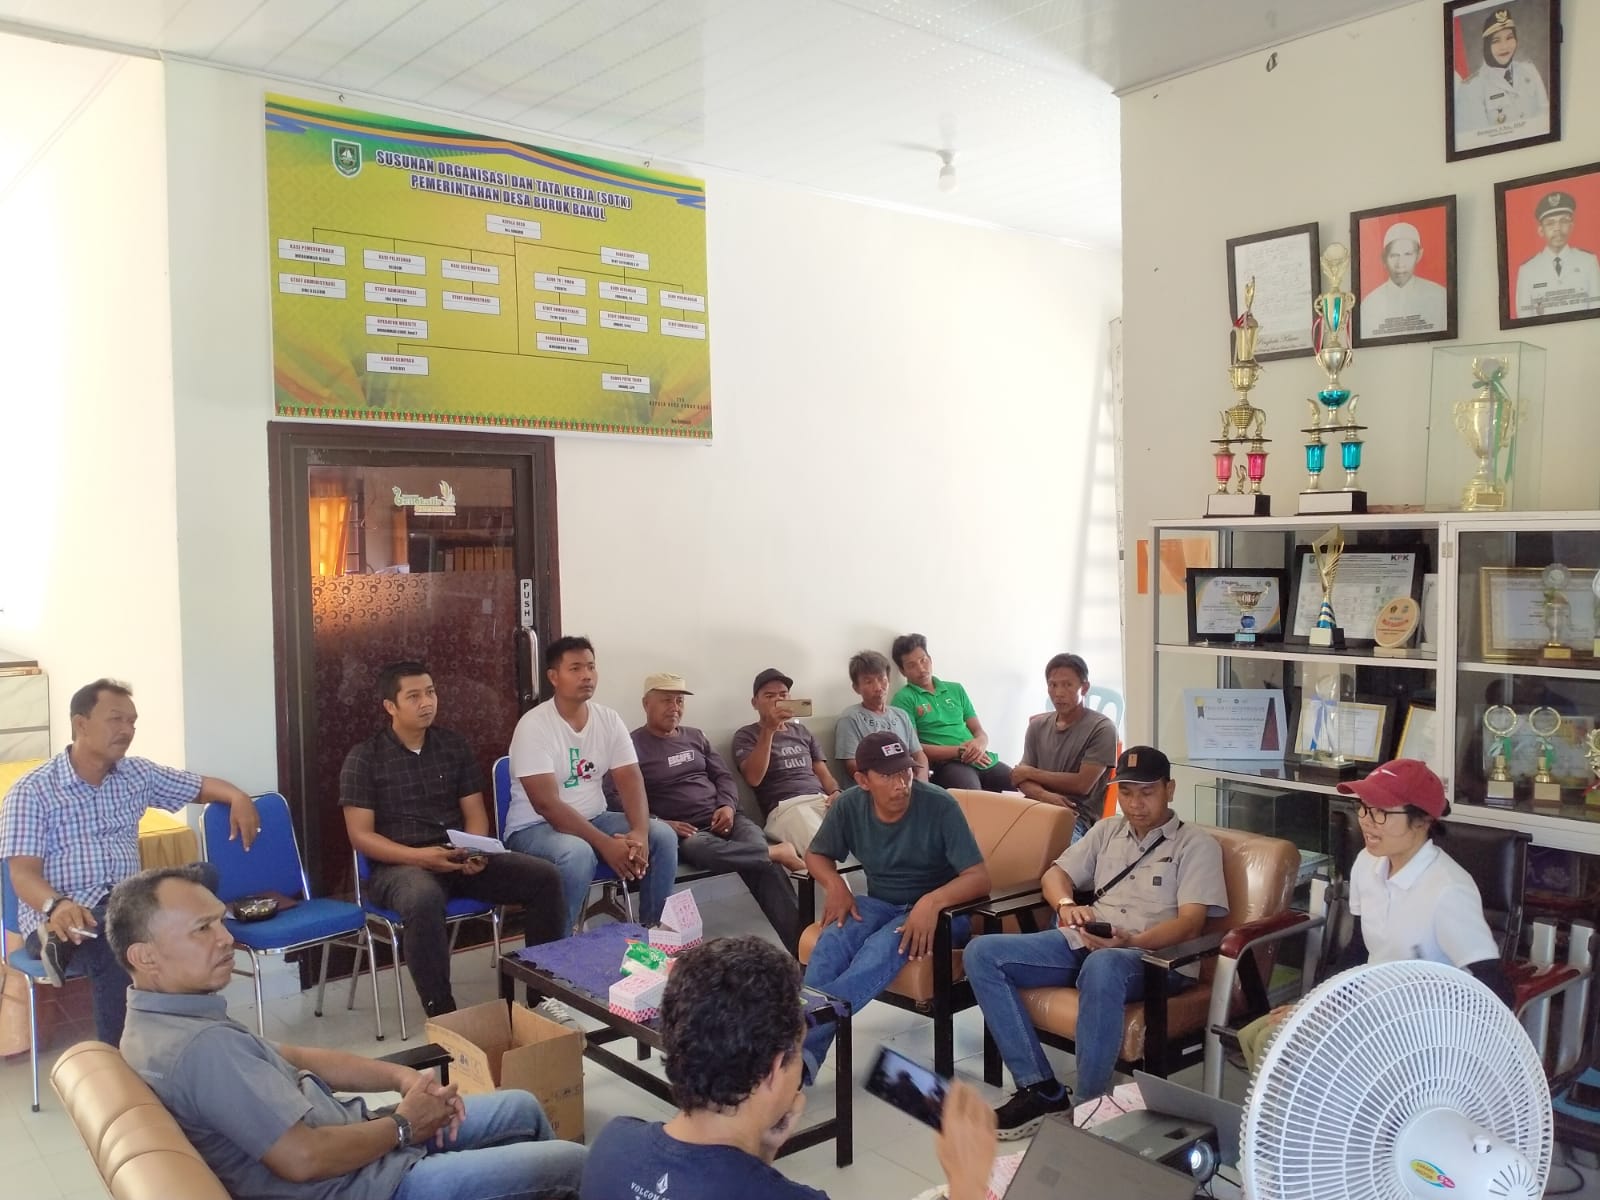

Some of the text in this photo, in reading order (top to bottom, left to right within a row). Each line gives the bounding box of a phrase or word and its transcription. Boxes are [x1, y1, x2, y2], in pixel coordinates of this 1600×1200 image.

[376, 149, 632, 209] SUSUNAN ORGANISASI DAN TATA KERJA (SOTK)
[410, 174, 607, 221] PEMERINTAHAN DESA BURUK BAKUL
[630, 1181, 660, 1200] VOLCOM
